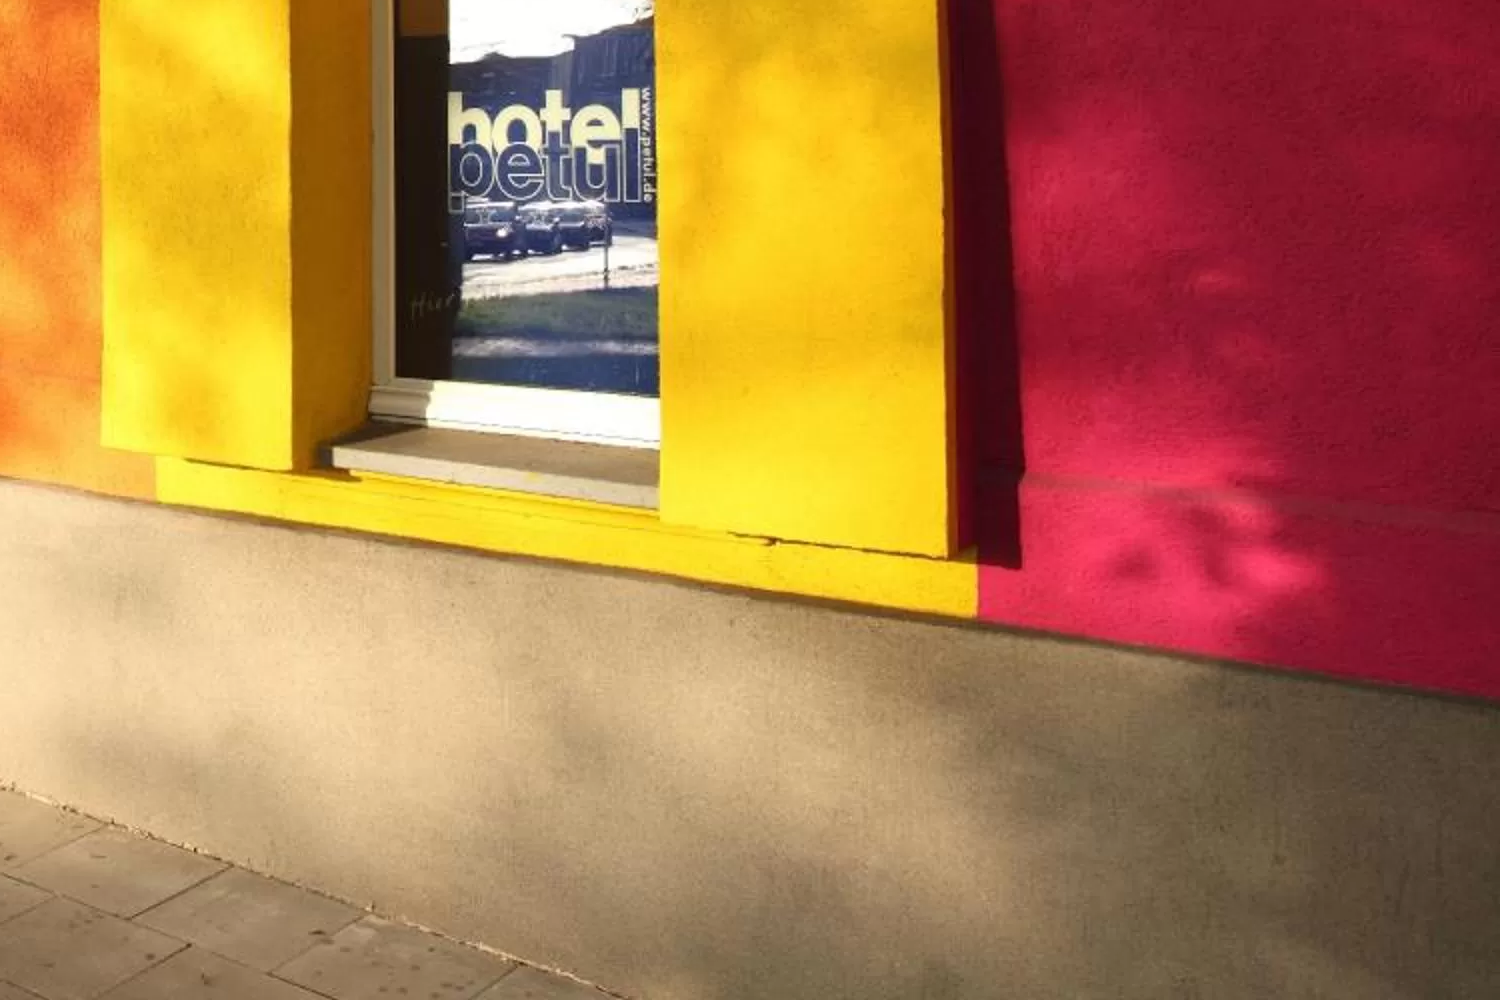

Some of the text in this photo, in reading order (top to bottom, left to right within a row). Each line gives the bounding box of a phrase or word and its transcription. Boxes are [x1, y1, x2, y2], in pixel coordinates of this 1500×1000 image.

[448, 88, 640, 164] hotel
[641, 86, 656, 203] www.petul.de
[448, 127, 644, 213] petul
